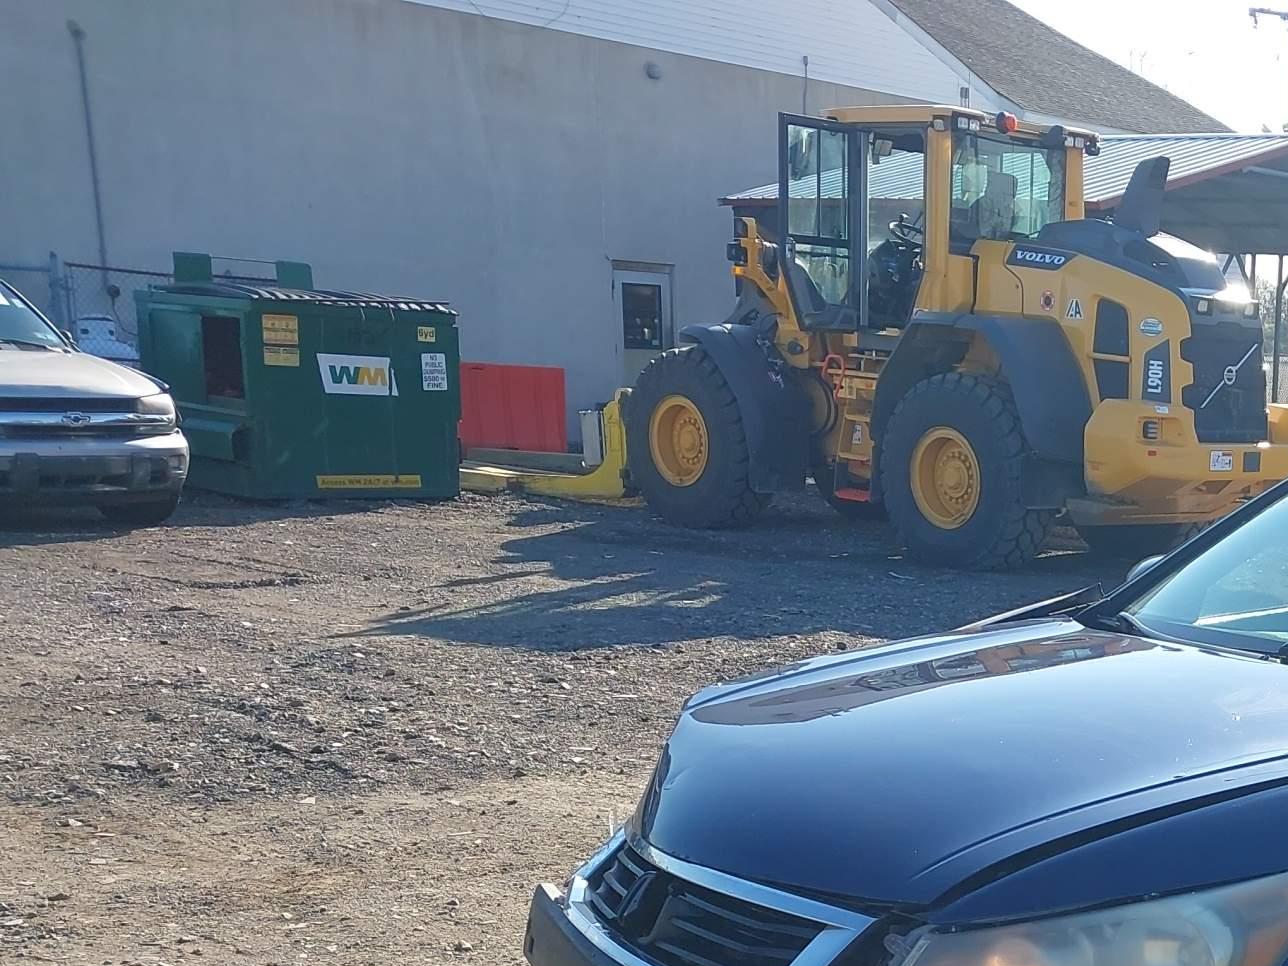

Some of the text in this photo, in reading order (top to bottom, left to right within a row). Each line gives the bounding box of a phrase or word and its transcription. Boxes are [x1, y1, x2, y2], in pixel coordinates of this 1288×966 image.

[1016, 250, 1065, 265] VOLVO
[418, 328, 435, 339] 6yd
[328, 364, 388, 386] WM
[1147, 359, 1164, 394] L90H
